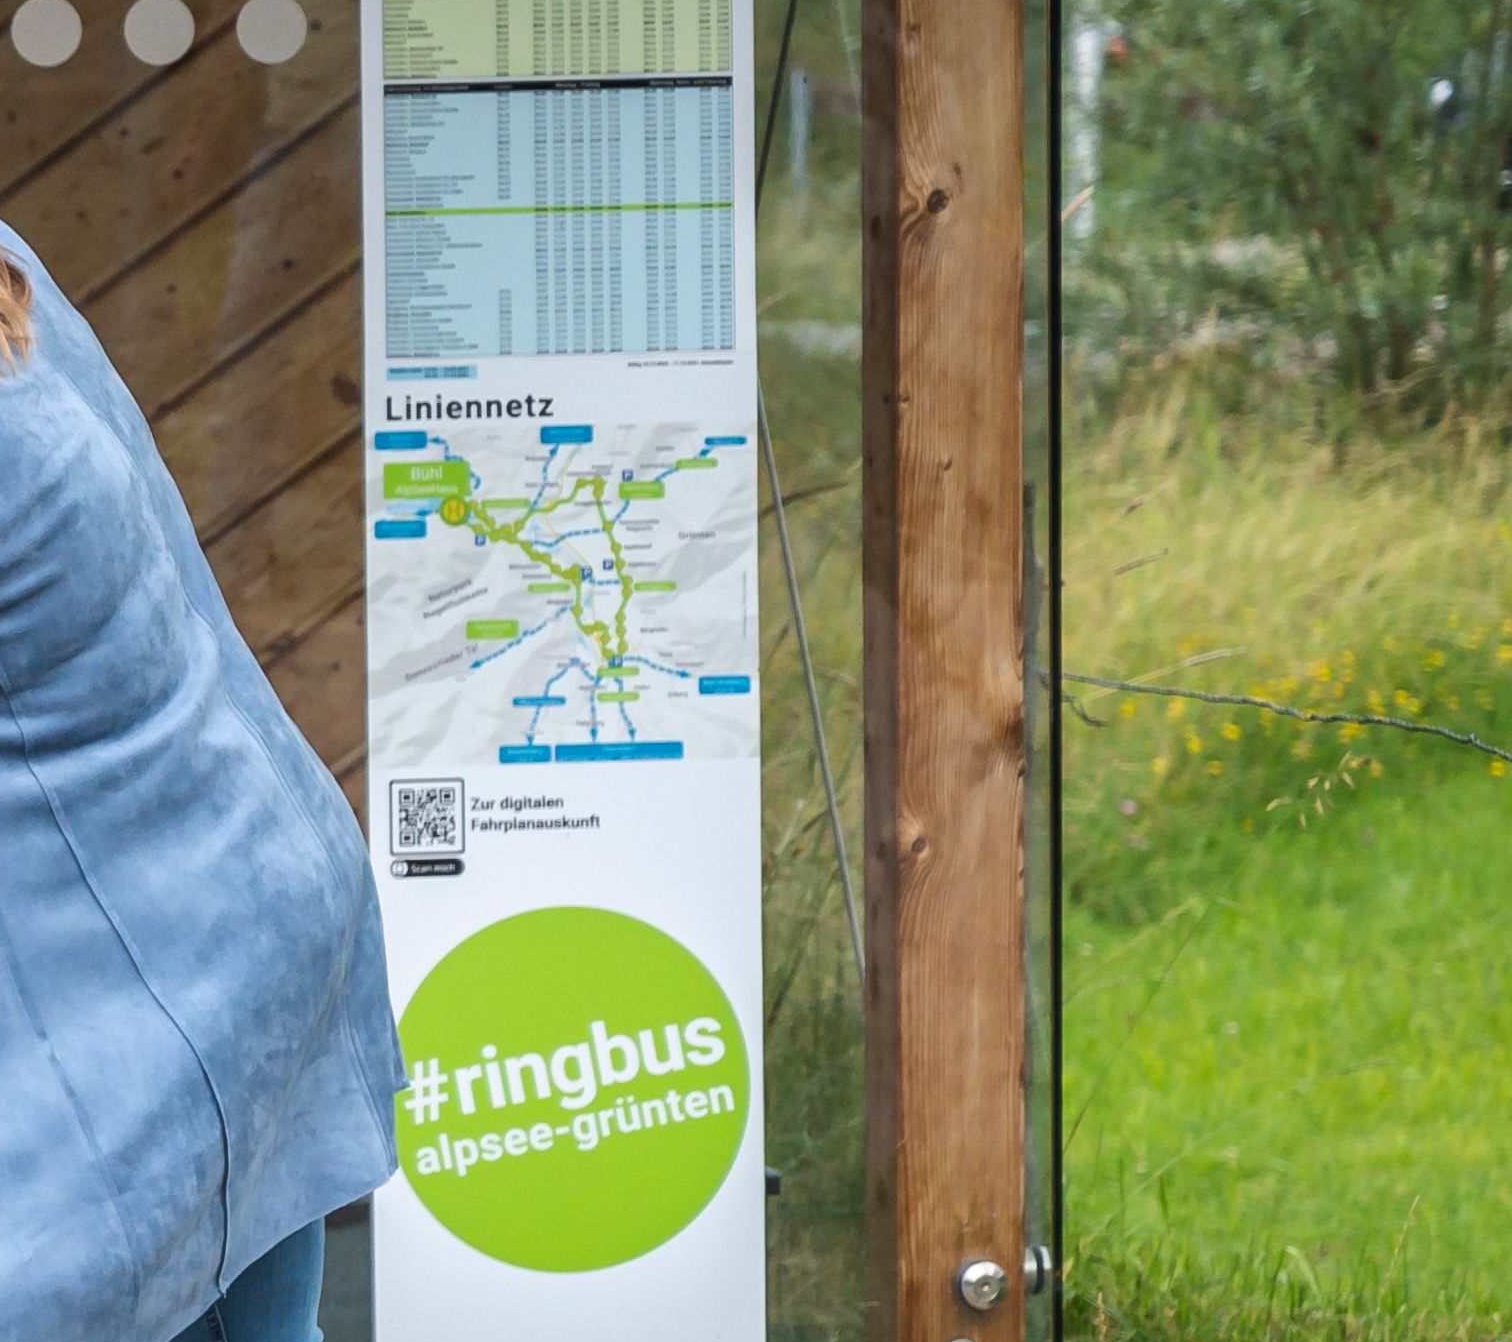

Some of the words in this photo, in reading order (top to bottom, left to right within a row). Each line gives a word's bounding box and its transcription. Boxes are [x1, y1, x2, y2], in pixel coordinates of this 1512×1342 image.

[386, 394, 555, 421] Liniennetz
[470, 797, 495, 811] Zur
[500, 795, 565, 812] digitalen
[470, 813, 601, 833] Fahrplanauskunft
[402, 1014, 727, 1125] #ringbus
[414, 1081, 736, 1177] alpsee-grünten
